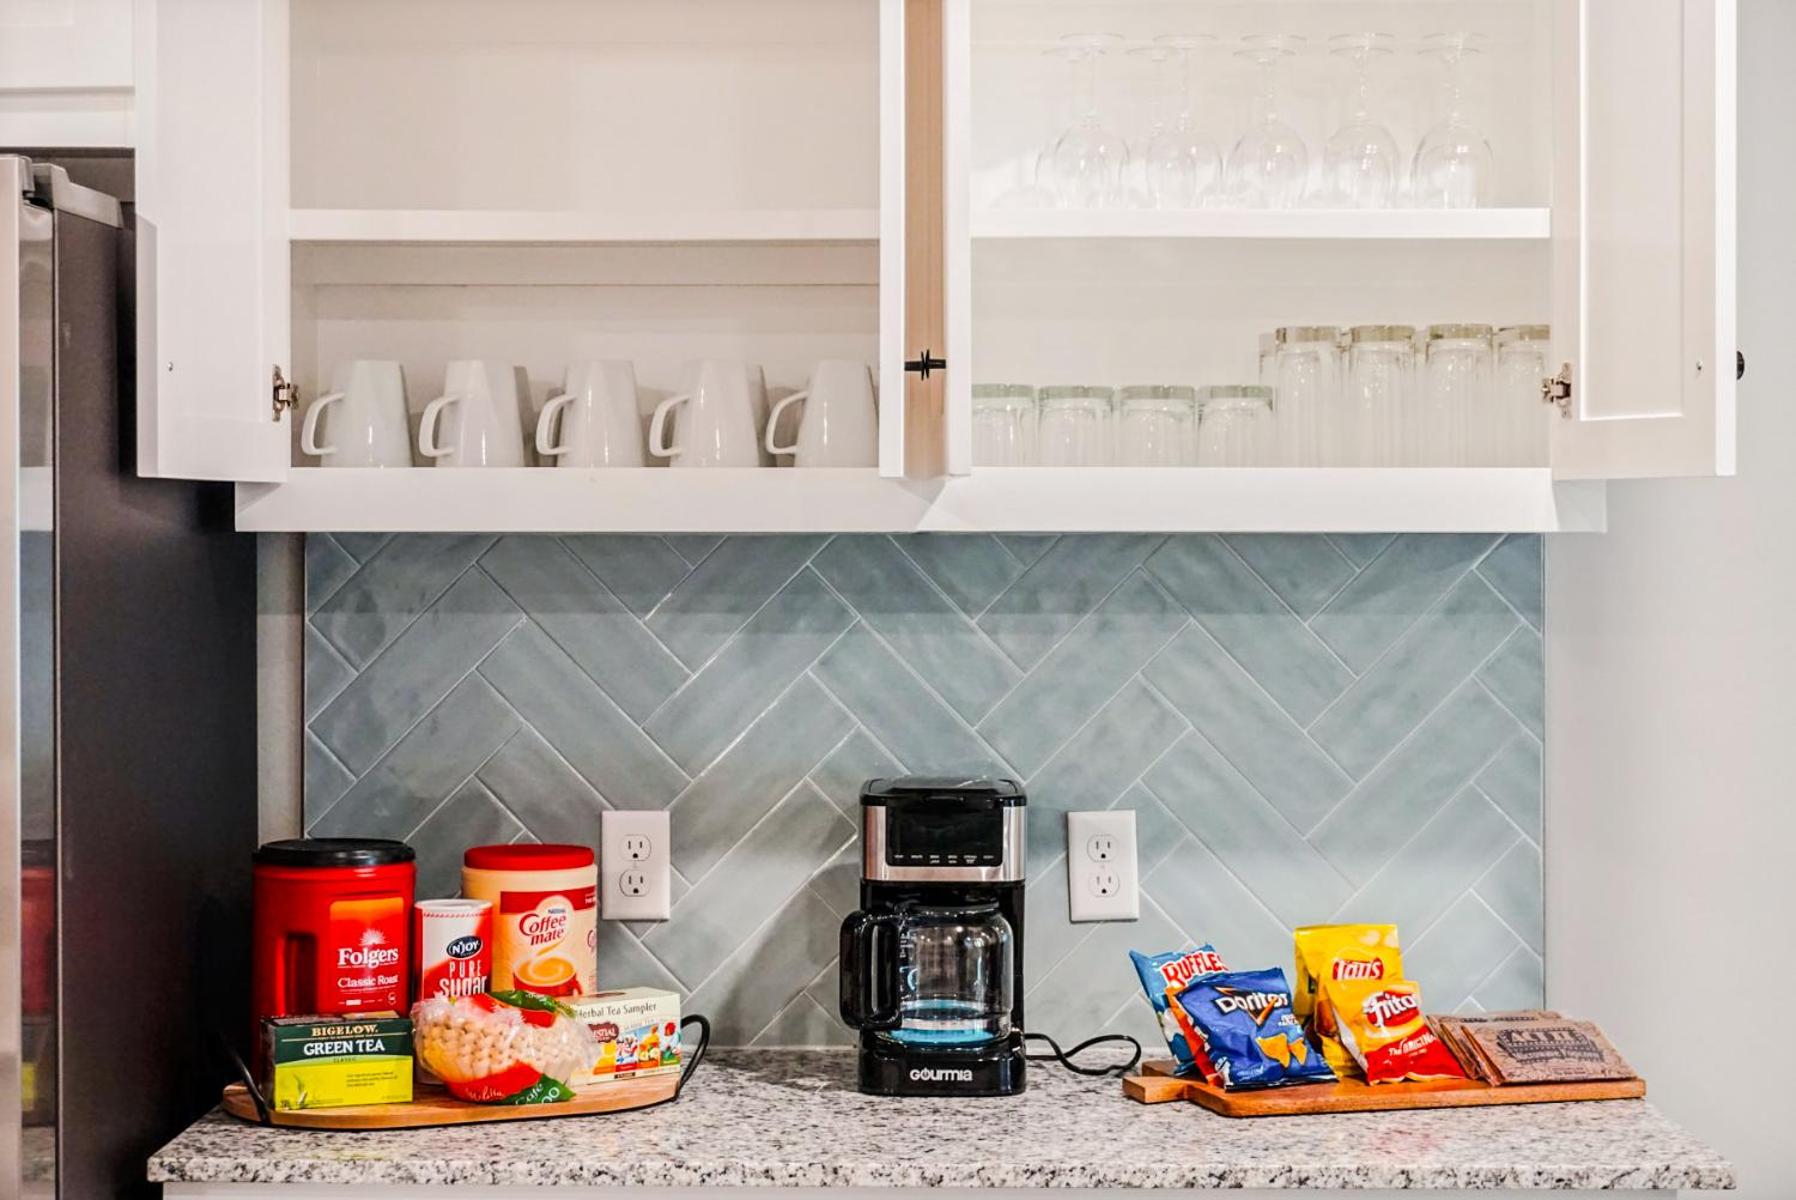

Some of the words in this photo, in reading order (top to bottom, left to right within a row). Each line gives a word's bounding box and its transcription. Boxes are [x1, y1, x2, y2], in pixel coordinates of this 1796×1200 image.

[518, 913, 567, 936] Coffee
[530, 928, 564, 946] mate
[337, 947, 399, 968] Folgers
[449, 960, 481, 977] PURE
[337, 977, 376, 988] Classic
[377, 974, 399, 985] Roast
[607, 1006, 621, 1016] Tea
[623, 1002, 657, 1014] Sampler
[311, 1024, 377, 1037] BIGELOW
[303, 1041, 354, 1056] GREEN
[355, 1039, 386, 1052] TEA
